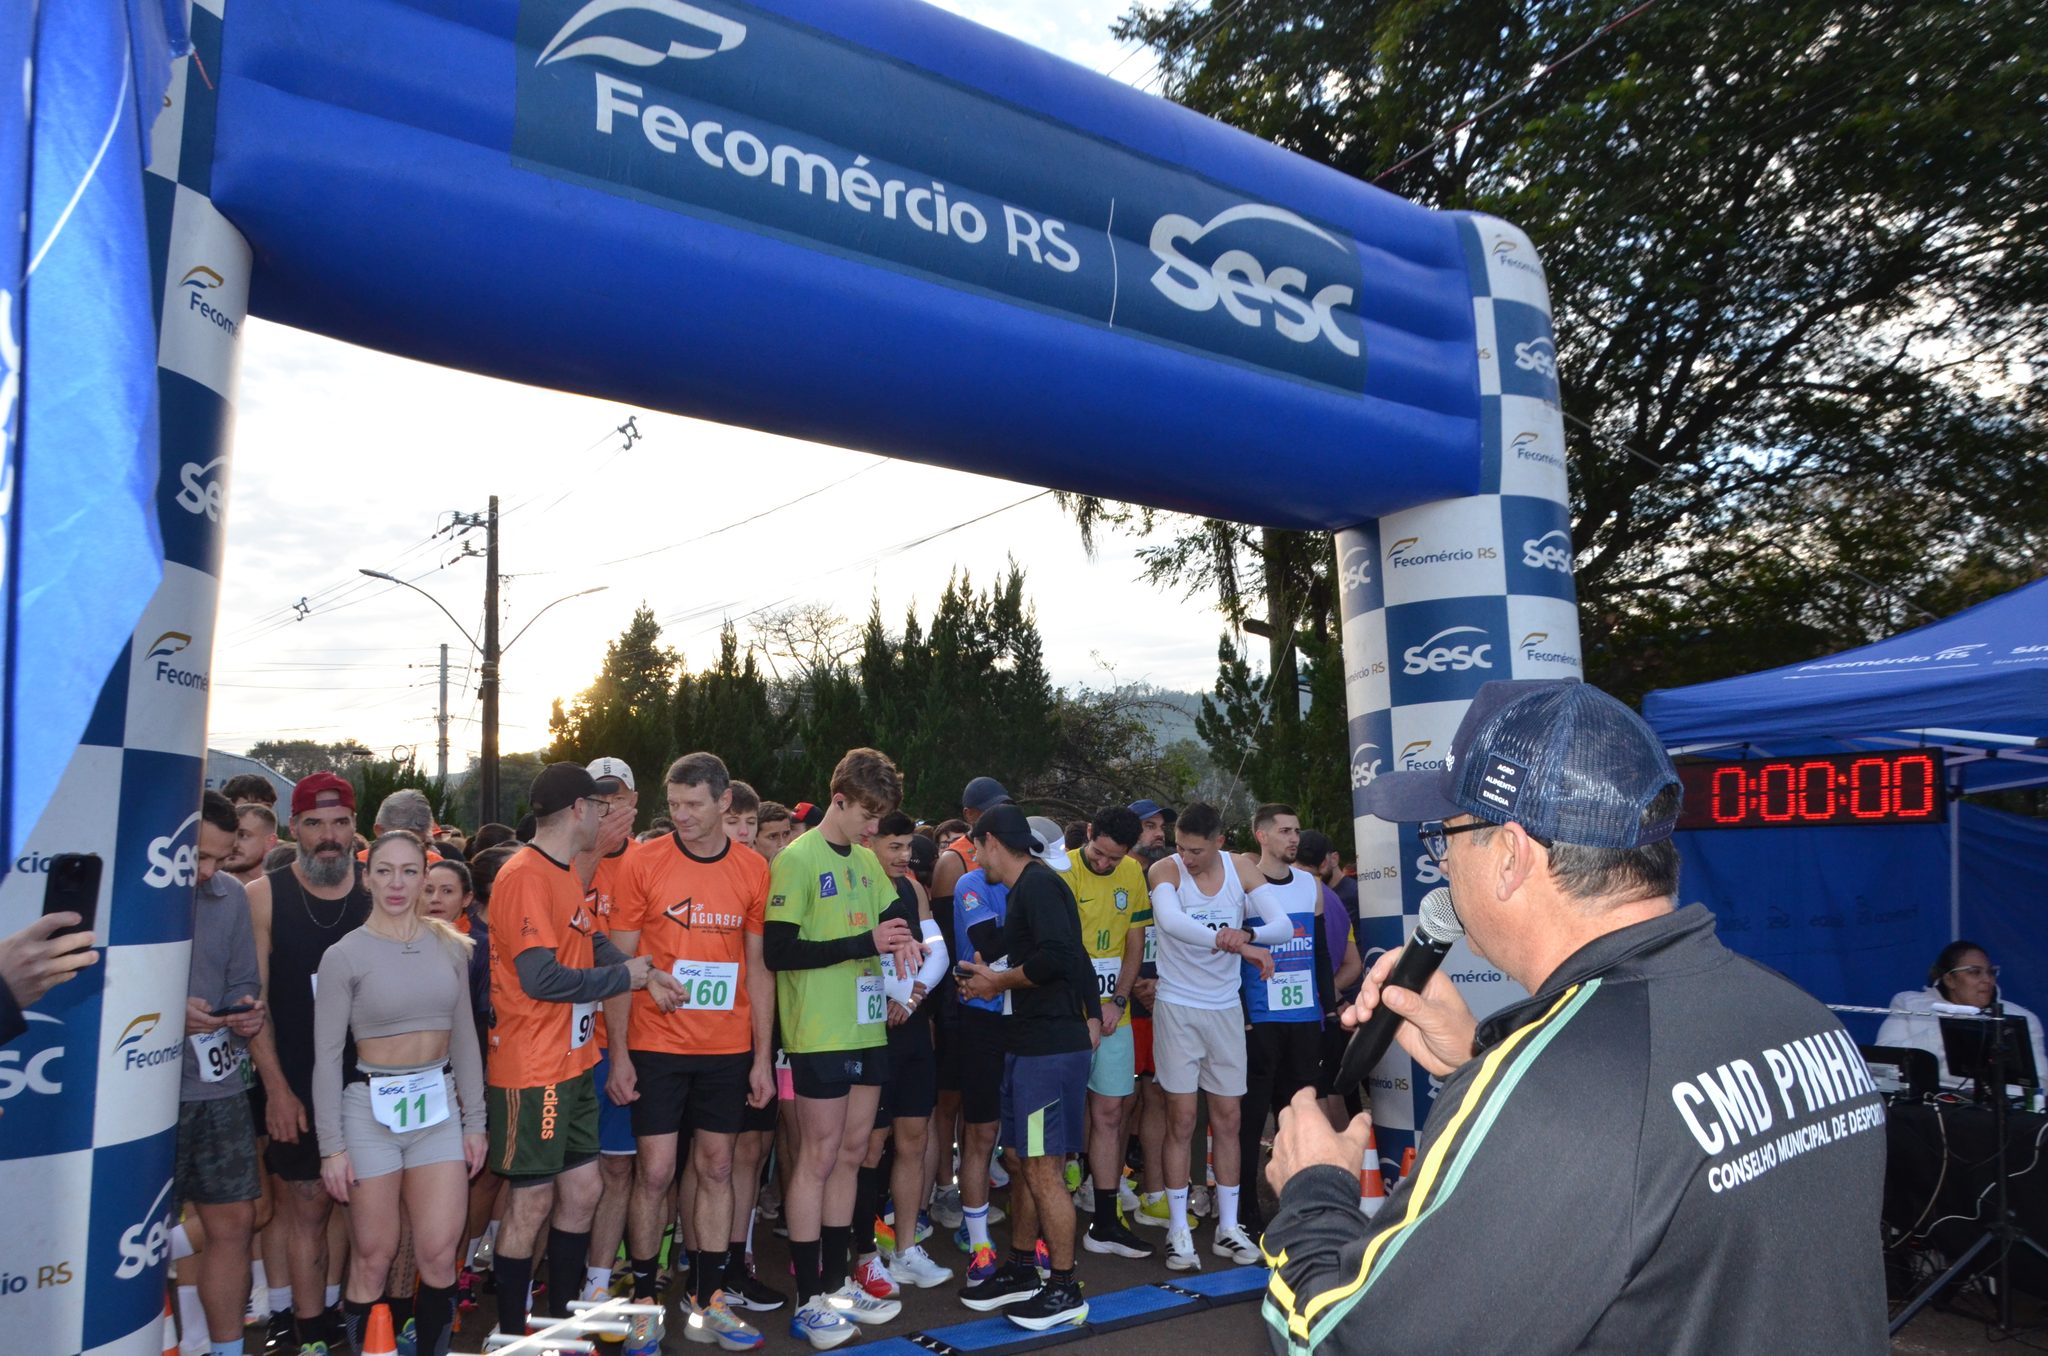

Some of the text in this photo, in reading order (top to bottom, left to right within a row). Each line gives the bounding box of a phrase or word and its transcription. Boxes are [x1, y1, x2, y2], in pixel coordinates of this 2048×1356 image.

[595, 72, 1080, 273] Fecomércio RS
[1149, 203, 1360, 357] Sesc
[1393, 547, 1497, 569] Fecomércio RS
[1371, 660, 1385, 675] RS
[1497, 764, 1515, 776] AGRO
[1485, 775, 1517, 793] ALIMENTO
[1712, 754, 1933, 823] 0:00:00
[1482, 790, 1509, 807] ENERGIA
[1383, 866, 1398, 879] RS
[1096, 929, 1111, 951] 10
[683, 979, 728, 1006] 160
[1281, 985, 1304, 1007] 85
[867, 993, 883, 1019] 62
[208, 1041, 235, 1077] 93
[1394, 1078, 1409, 1091] RS
[394, 1093, 426, 1127] 11
[1671, 1059, 1773, 1156] CMD
[1708, 1142, 1777, 1194] CONSELHO
[1776, 1121, 1832, 1163] MUNICIPAL
[1831, 1113, 1849, 1141] DE
[37, 1260, 73, 1290] RS
